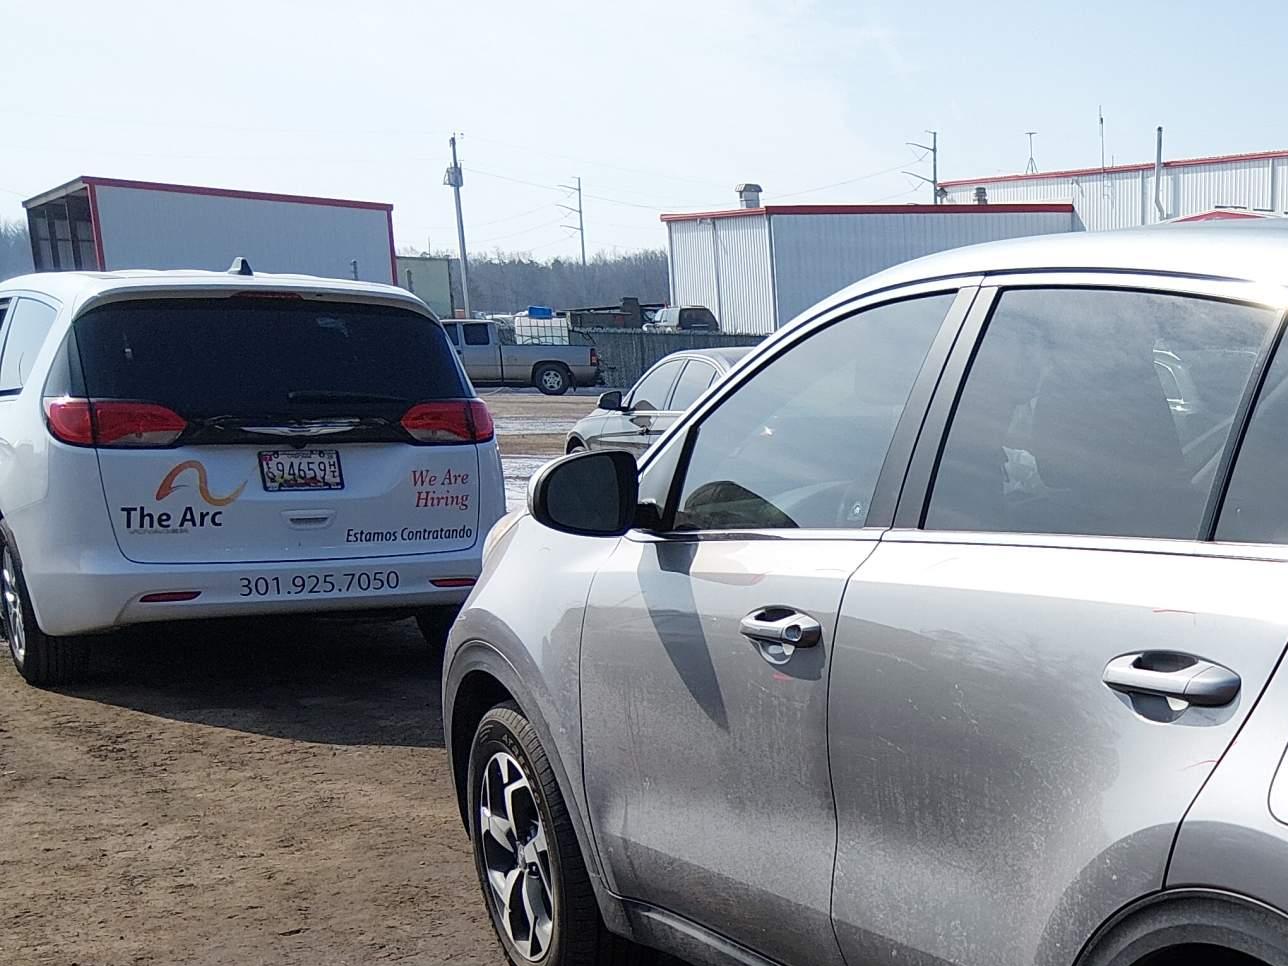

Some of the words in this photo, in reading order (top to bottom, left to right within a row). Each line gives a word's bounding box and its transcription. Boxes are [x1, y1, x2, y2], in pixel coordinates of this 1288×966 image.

[411, 469, 437, 487] We
[441, 468, 469, 486] Are
[415, 490, 469, 510] Hiring
[120, 506, 171, 528] The
[179, 506, 223, 527] Arc
[346, 528, 398, 542] Estamos
[400, 525, 473, 541] Contratando
[239, 571, 400, 596] 301.925.7050
